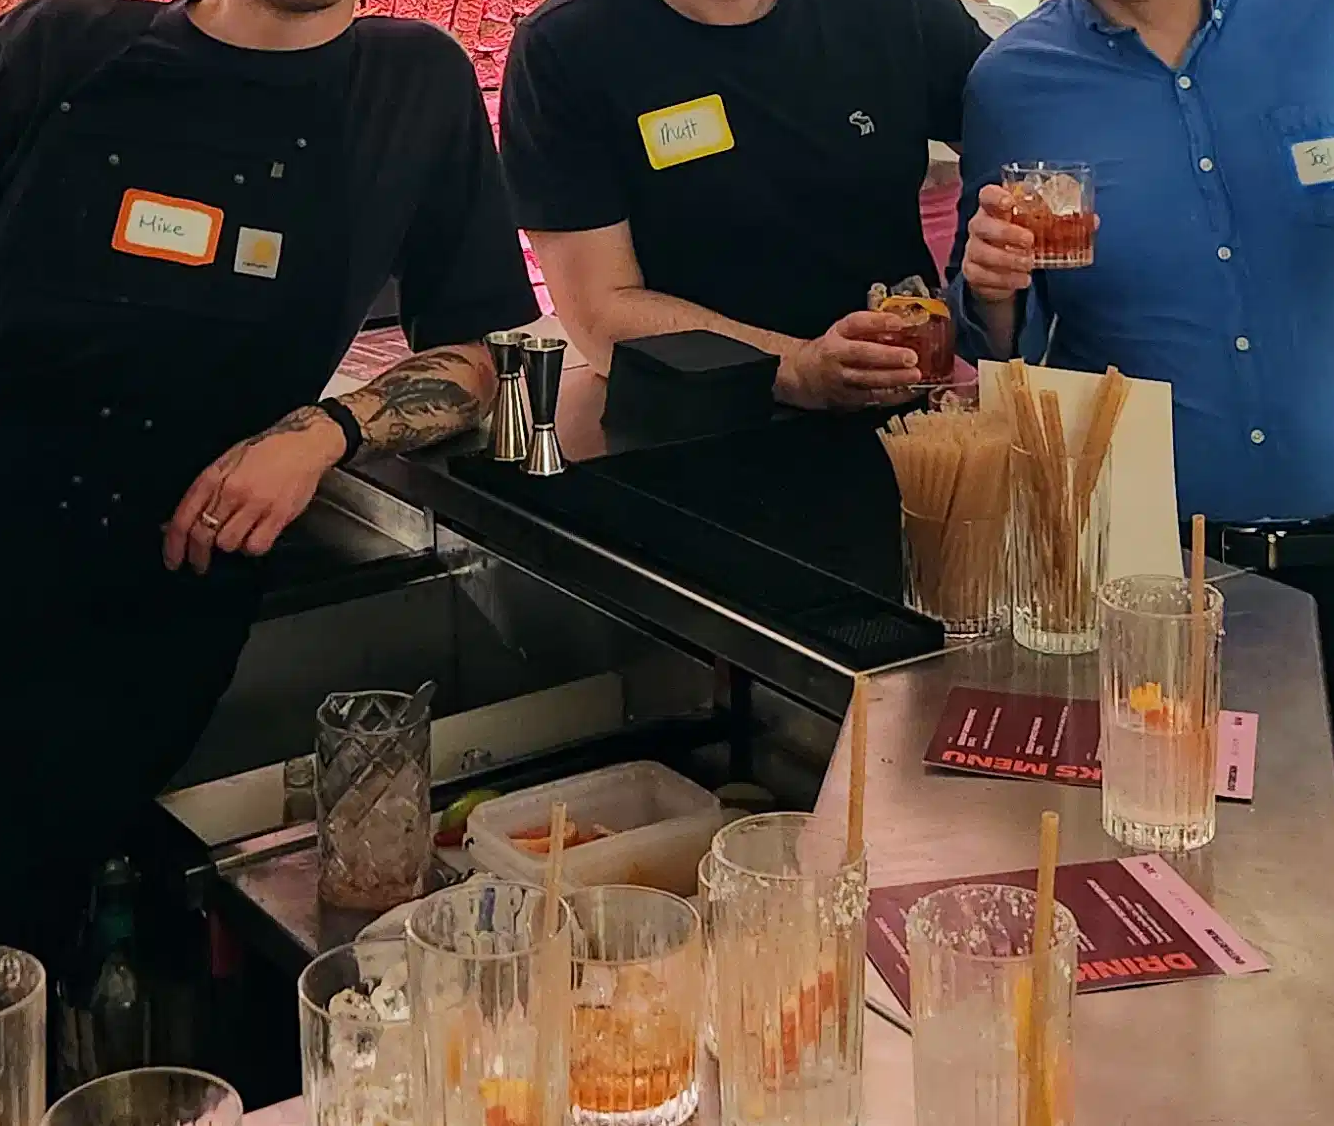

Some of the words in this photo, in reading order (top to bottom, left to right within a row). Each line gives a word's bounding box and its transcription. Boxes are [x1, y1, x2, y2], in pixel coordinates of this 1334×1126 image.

[139, 214, 186, 236] Mike
[942, 750, 1049, 776] MENU
[1075, 952, 1198, 982] DRINK
